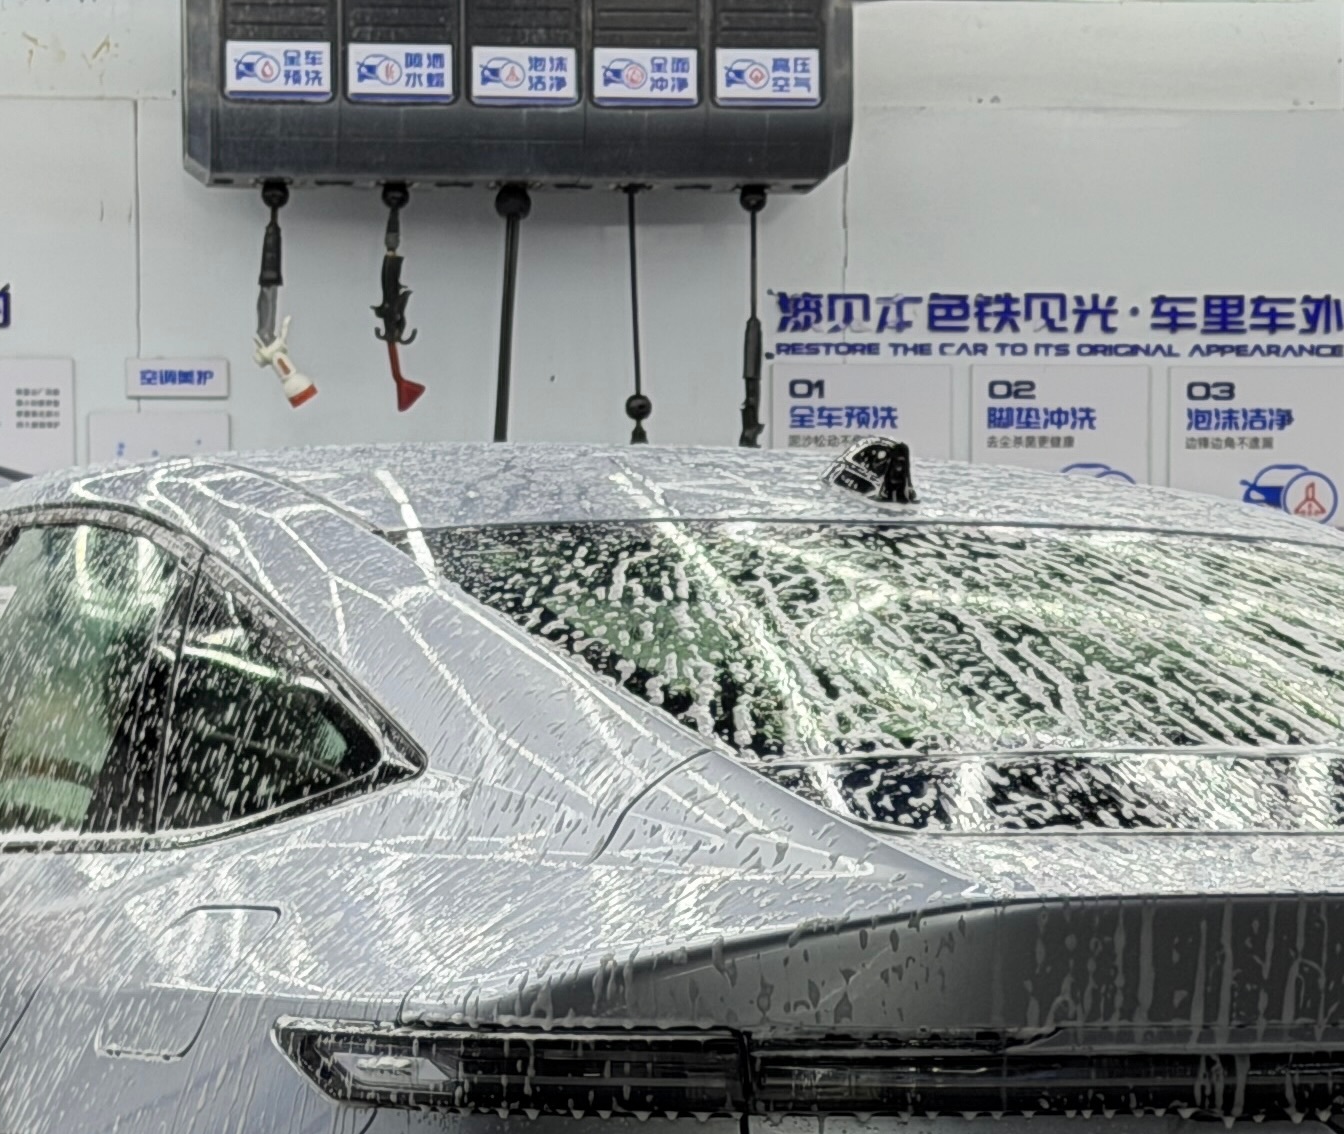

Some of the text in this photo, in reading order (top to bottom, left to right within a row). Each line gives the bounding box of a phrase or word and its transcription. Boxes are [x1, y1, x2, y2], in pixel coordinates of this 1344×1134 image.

[282, 49, 323, 68] 全车
[404, 52, 445, 69] 喷洒
[527, 56, 568, 73] 泡沫
[650, 56, 690, 74] 全面
[771, 57, 811, 74] 高压
[282, 69, 323, 87] 预洗
[404, 71, 445, 88] 水蜡
[527, 74, 567, 92] 洁净
[649, 76, 689, 93] 冲净
[771, 75, 812, 93] 空气
[775, 341, 1344, 358] RESTORE THE CAR TO ITS ORIGINAL APPEARANCE
[139, 369, 214, 386] 空调美护
[788, 378, 825, 399] 01
[988, 379, 1036, 400] 02
[1186, 381, 1236, 402] 03
[789, 405, 898, 429] 全车预洗
[986, 406, 1097, 431] 脚垫冲洗
[1186, 407, 1295, 431] 泡沫洁净
